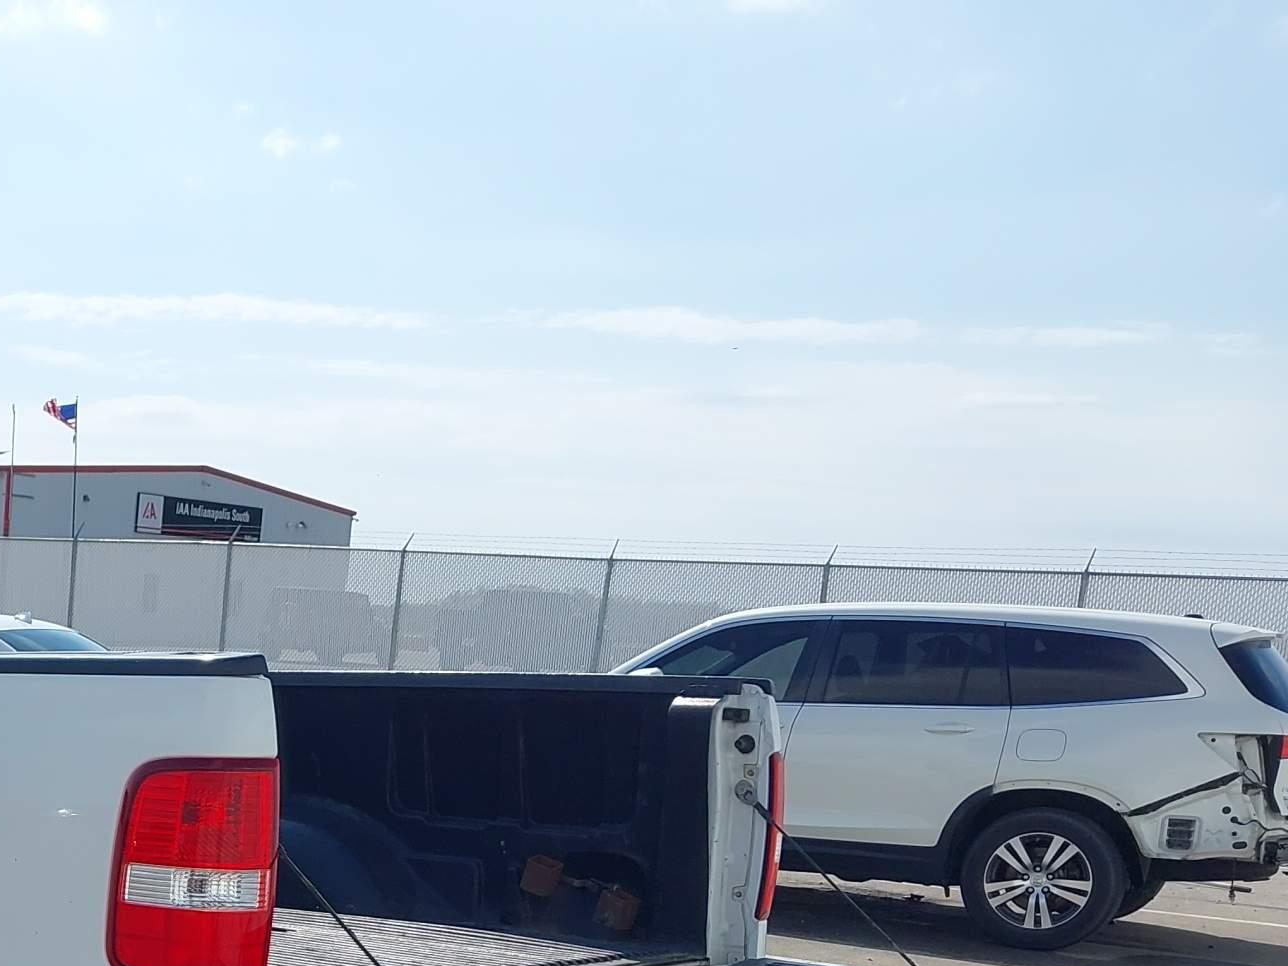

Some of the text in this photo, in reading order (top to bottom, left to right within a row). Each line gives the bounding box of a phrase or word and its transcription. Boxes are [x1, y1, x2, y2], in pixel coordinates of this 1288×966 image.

[175, 502, 250, 523] IAA Indianapolis South
